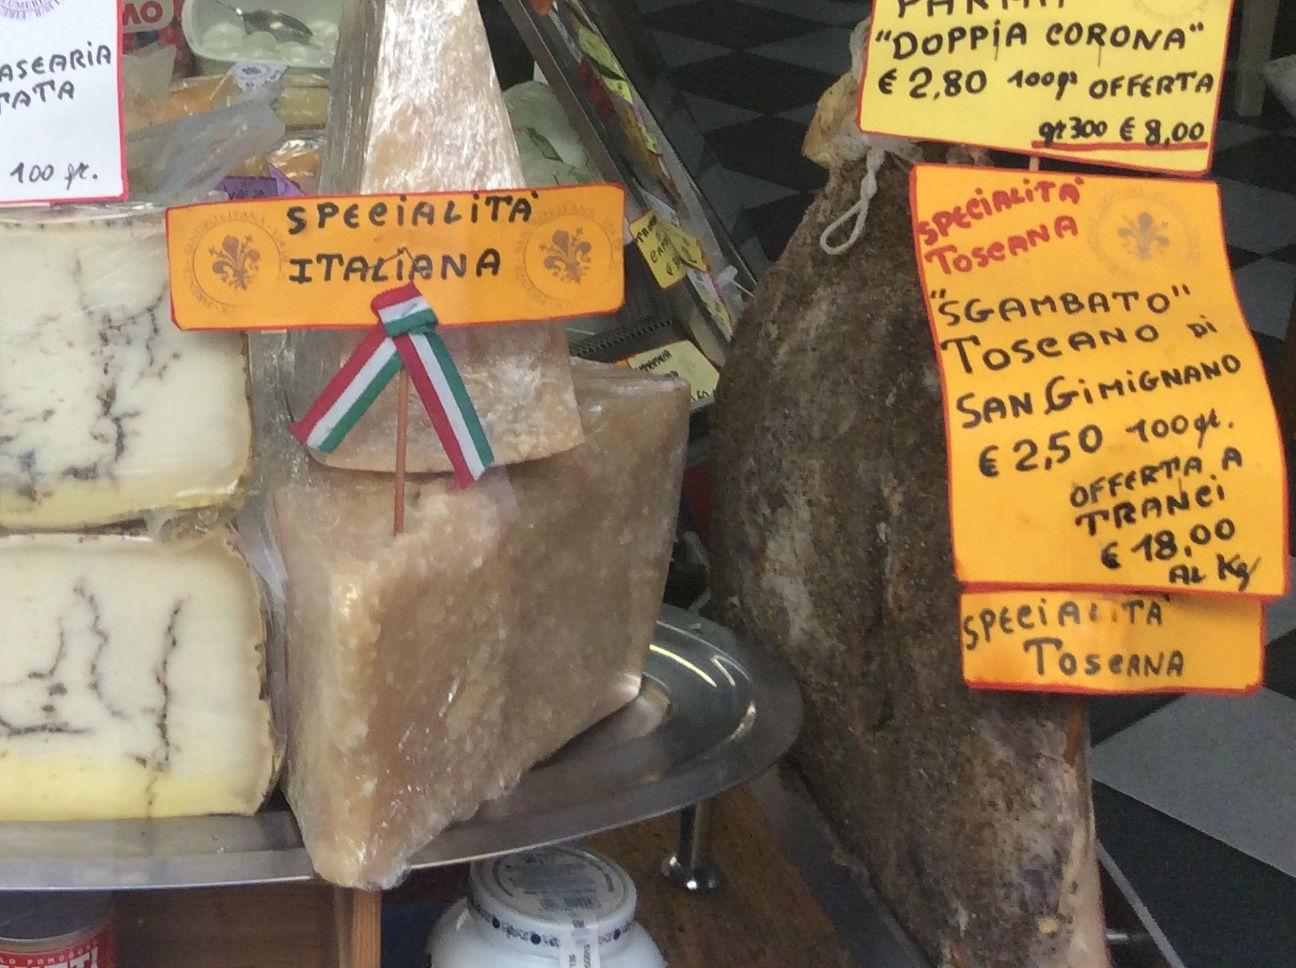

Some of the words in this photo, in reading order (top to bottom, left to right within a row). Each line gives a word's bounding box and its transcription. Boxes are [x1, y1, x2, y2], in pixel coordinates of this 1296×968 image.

[878, 68, 897, 95] €
[909, 66, 987, 100] 2,80
[1088, 72, 1214, 99] OFFERTA
[1119, 116, 1136, 142] €
[1144, 120, 1205, 146] 8,00
[289, 247, 502, 284] ITALIANA
[924, 214, 1079, 275] TOSCANA
[941, 324, 1160, 375] TOSCANO
[1186, 314, 1218, 338] DI
[956, 391, 1033, 429] SAN
[1044, 353, 1242, 416] GIMIGNANO
[978, 445, 1000, 477] €
[1012, 424, 1103, 472] 2,50
[1069, 456, 1202, 508] OFFERTA
[1221, 446, 1243, 470] A
[1074, 473, 1225, 536] TRANCI
[1100, 542, 1121, 569] €
[1131, 518, 1236, 561] 18,00
[1169, 564, 1206, 584] AL
[1023, 637, 1184, 678] TOSCANA
